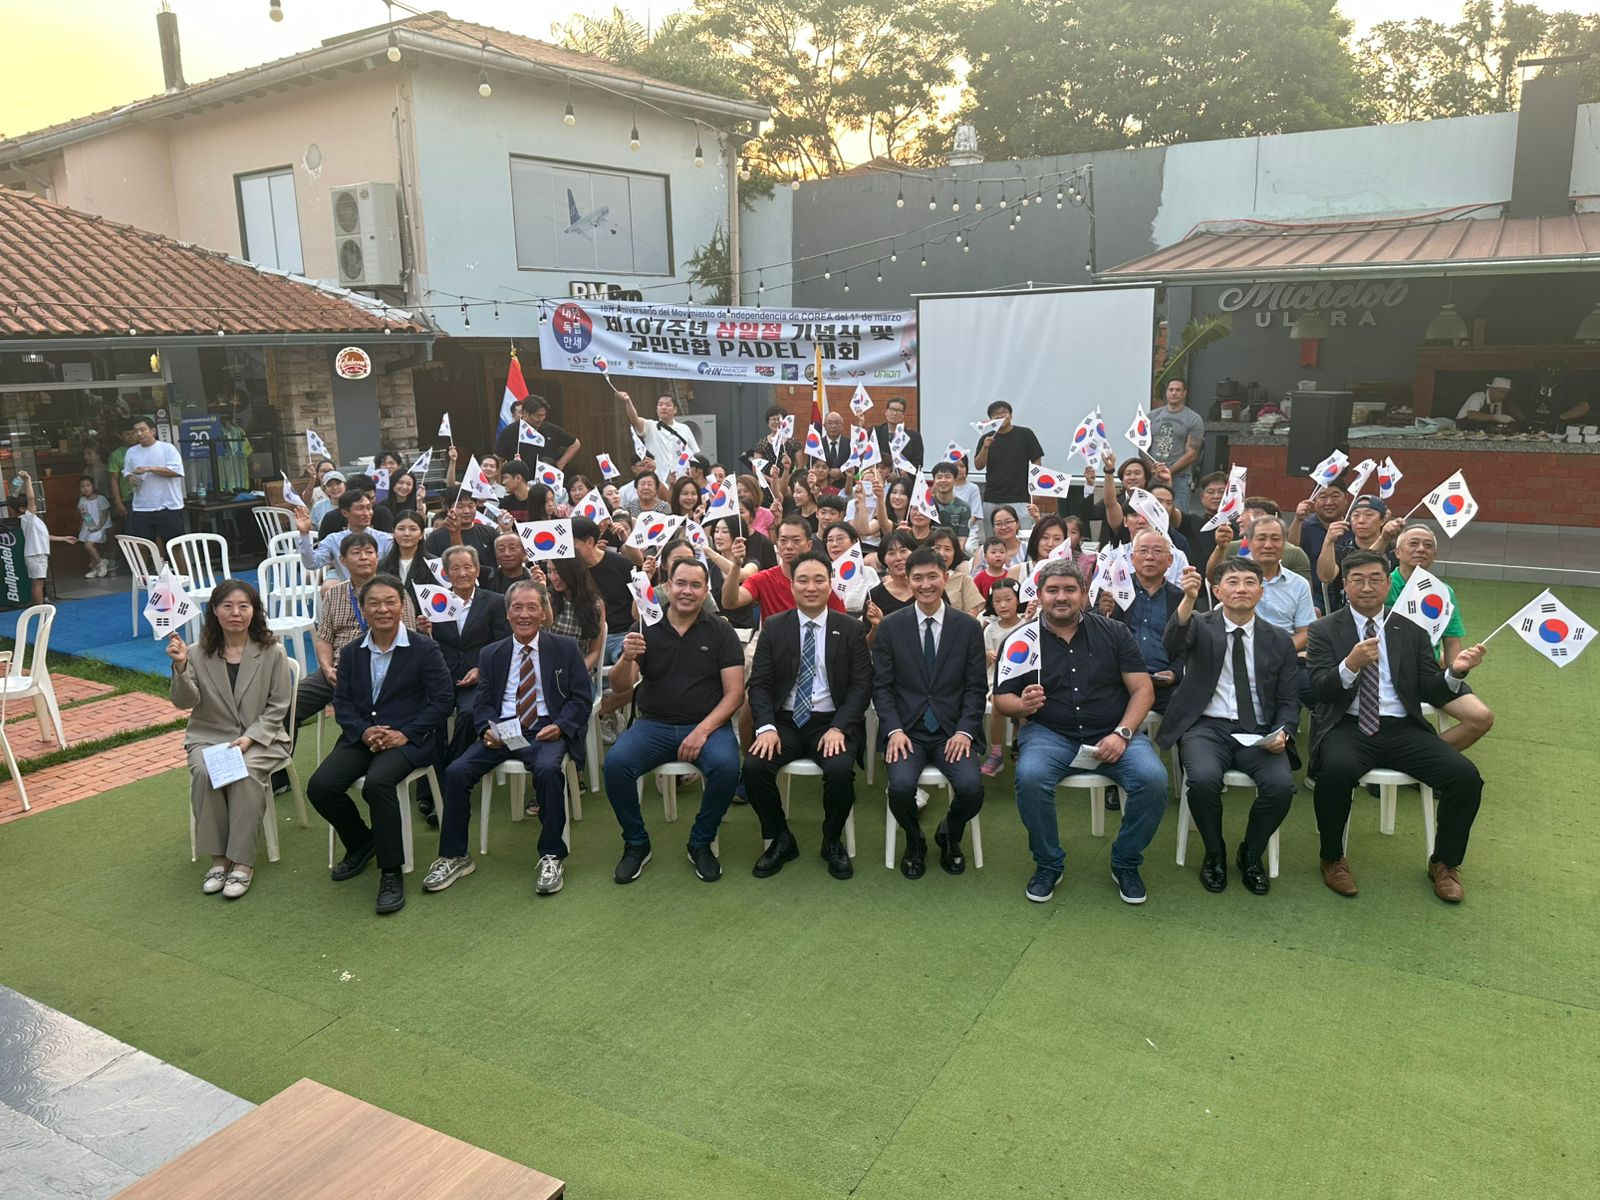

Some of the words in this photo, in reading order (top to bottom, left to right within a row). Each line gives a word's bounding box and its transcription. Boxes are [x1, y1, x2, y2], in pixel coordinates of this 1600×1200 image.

[1218, 279, 1409, 311] Michelob
[659, 307, 669, 315] del
[727, 311, 787, 320] ndependencia
[789, 312, 799, 320] de
[802, 312, 833, 320] COREA
[1256, 310, 1377, 327] ULRA
[603, 315, 708, 337] 제107주년
[716, 321, 782, 340] 삼일절
[791, 324, 861, 341] 기념식
[870, 325, 895, 341] 및
[563, 337, 582, 350] 만세
[628, 335, 711, 356] 교민단합
[718, 340, 806, 359] PADEL
[0, 545, 19, 602] Bullpadel
